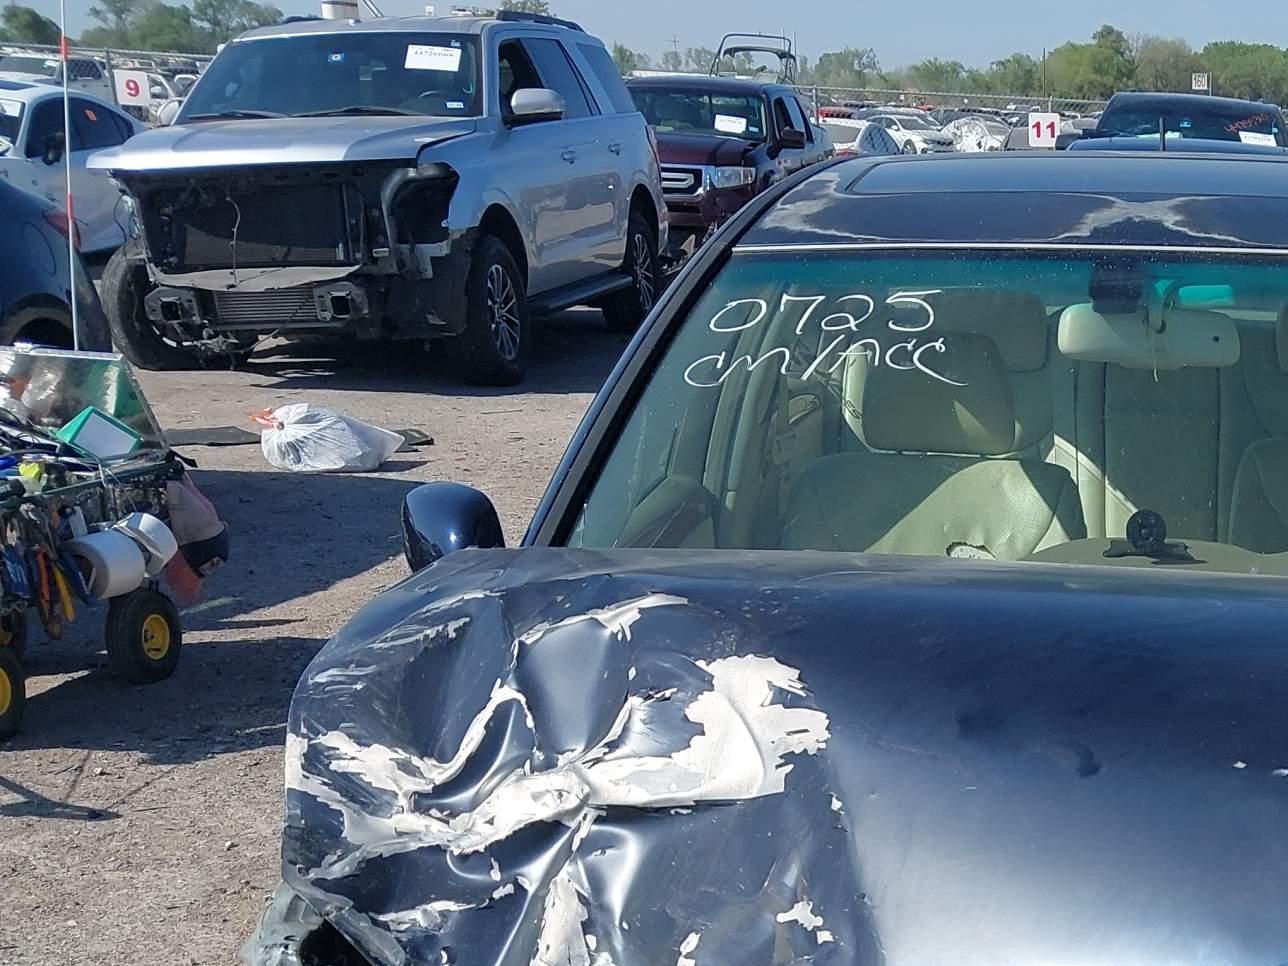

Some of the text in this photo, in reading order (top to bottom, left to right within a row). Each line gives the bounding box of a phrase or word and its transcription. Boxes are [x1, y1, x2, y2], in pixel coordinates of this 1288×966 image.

[125, 79, 140, 97] 9
[1193, 74, 1206, 88] 160
[1032, 121, 1056, 139] 11
[708, 288, 944, 335] 0725
